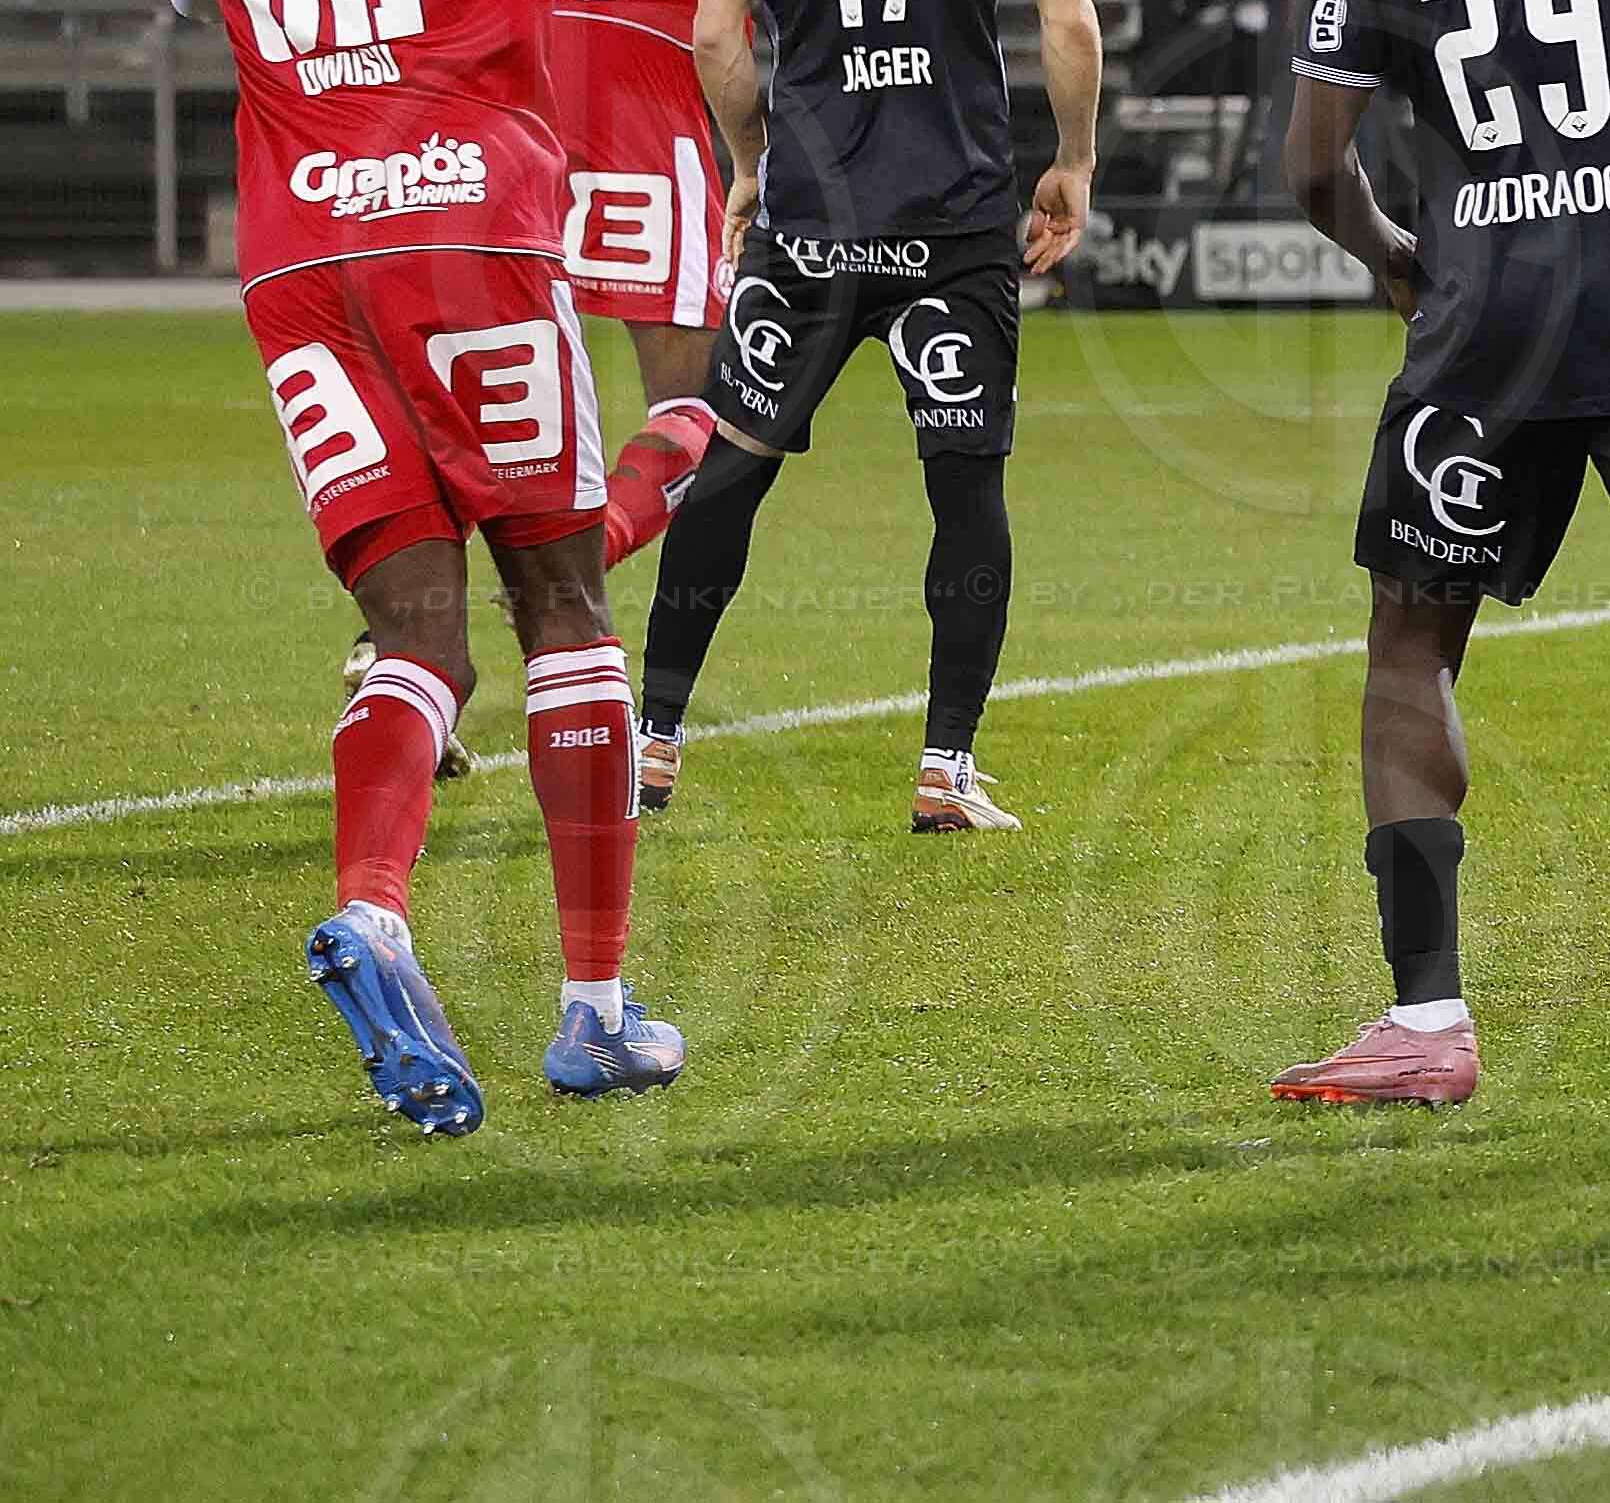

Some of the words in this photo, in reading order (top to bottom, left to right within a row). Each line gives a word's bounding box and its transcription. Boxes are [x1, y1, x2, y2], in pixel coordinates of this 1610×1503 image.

[841, 45, 934, 94] JÄGER
[330, 188, 386, 218] SOFT
[404, 182, 487, 206] DRINKS
[319, 463, 392, 507] STEIERMARK
[1390, 517, 1503, 565] BENDERN
[549, 726, 612, 748] 1902
